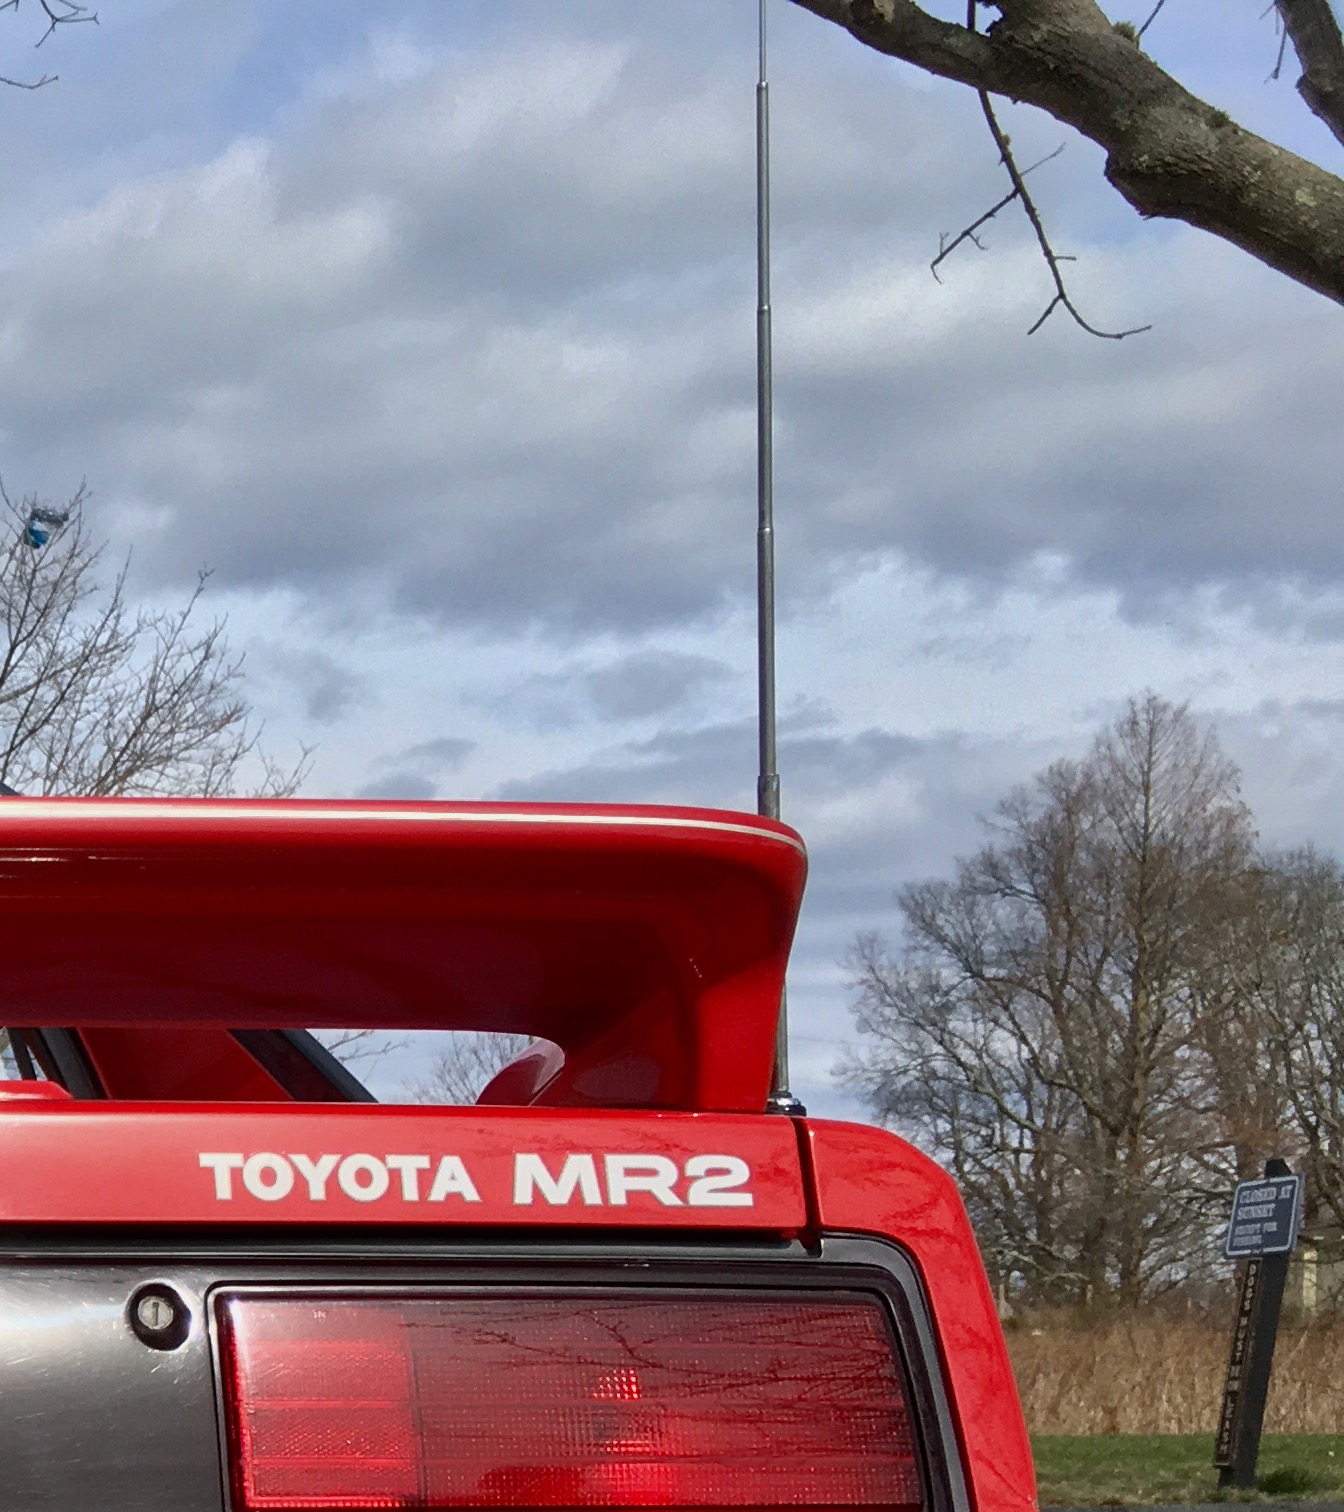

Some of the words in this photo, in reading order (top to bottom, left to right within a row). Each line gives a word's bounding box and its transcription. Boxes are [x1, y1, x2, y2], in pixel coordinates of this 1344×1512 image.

[198, 1151, 482, 1202] TOYOTA
[512, 1152, 754, 1207] MR2
[1239, 1187, 1277, 1203] CLOSED
[1278, 1185, 1293, 1199] AT
[1237, 1203, 1276, 1220] SUNSET
[1244, 1263, 1257, 1311] DOGS
[1235, 1316, 1248, 1361] MUST
